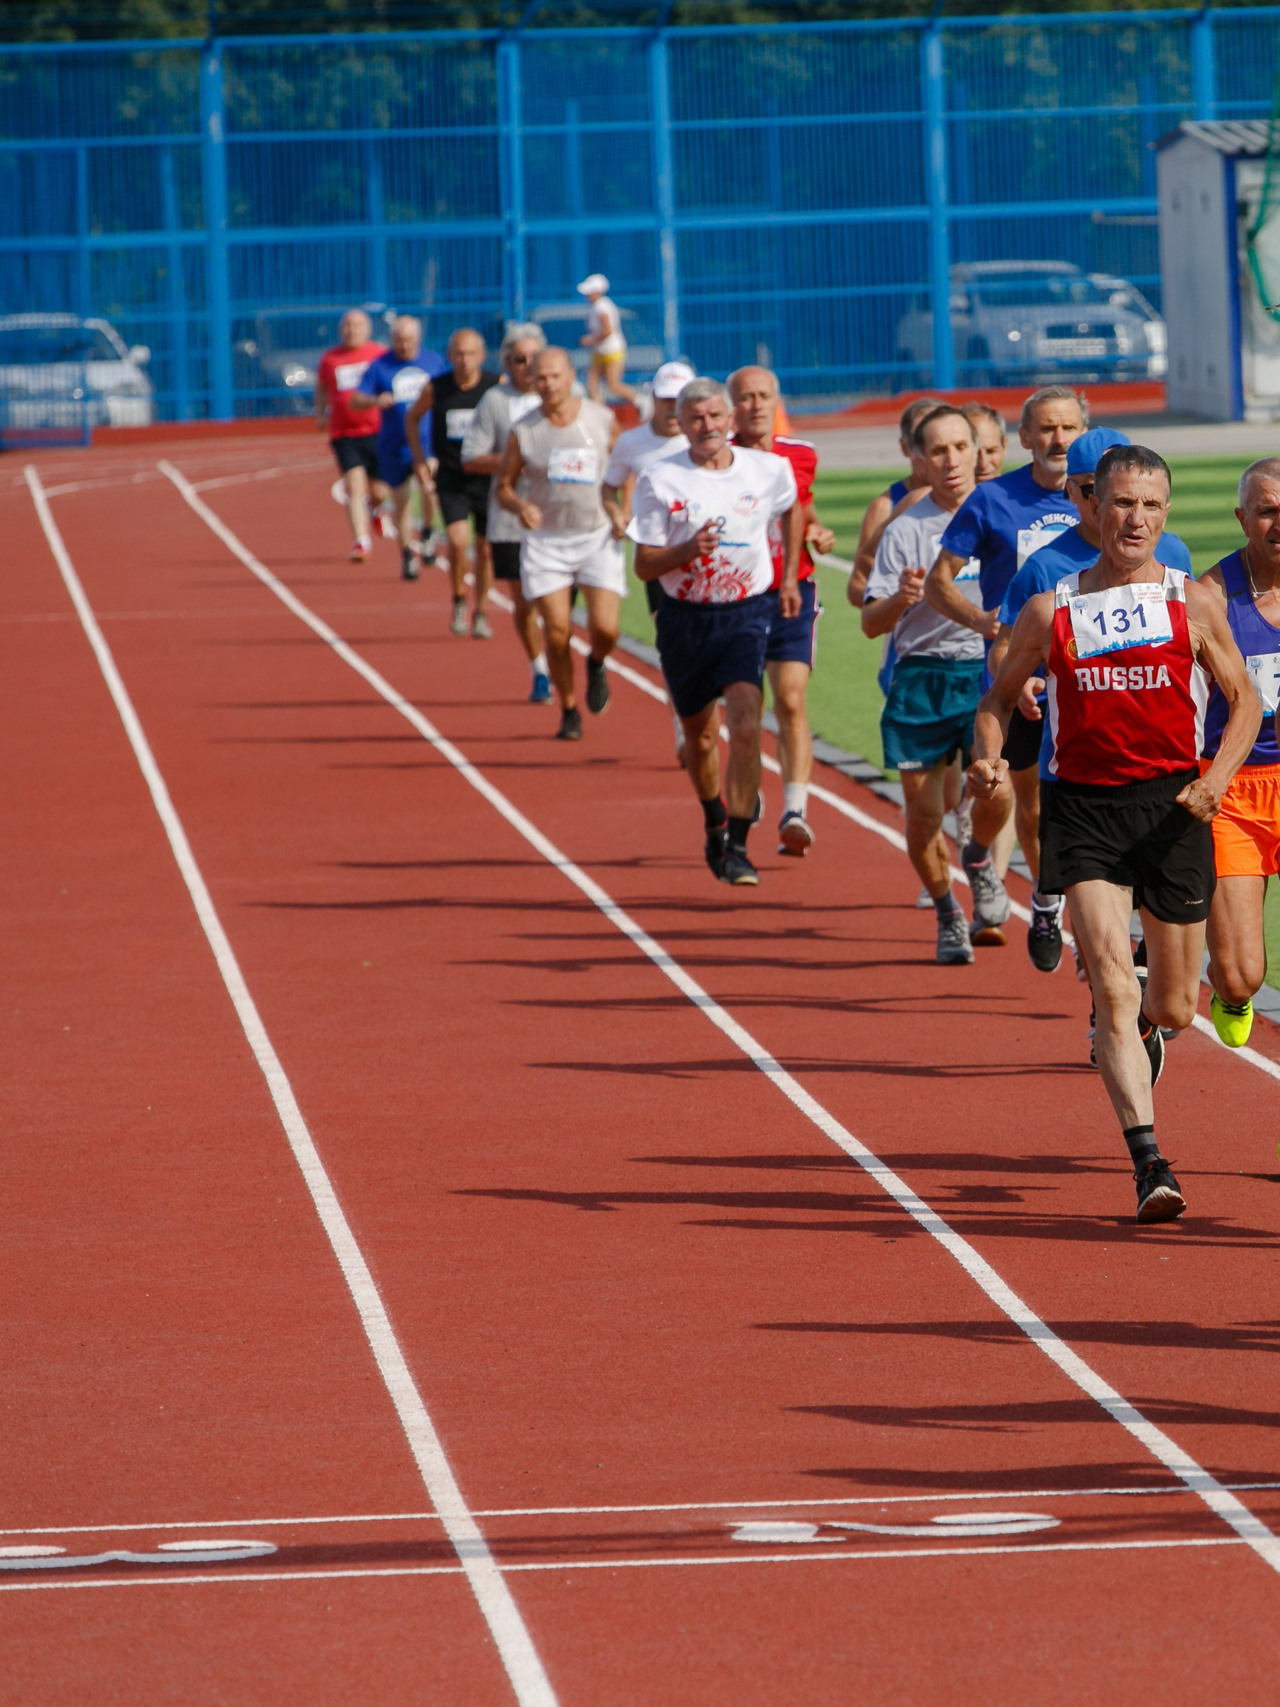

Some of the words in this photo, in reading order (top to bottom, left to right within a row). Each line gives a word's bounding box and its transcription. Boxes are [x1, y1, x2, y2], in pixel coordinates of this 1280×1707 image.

[1042, 513, 1080, 528] ПЕНСИО
[1093, 603, 1147, 636] 131
[1074, 664, 1172, 691] RUSSIA
